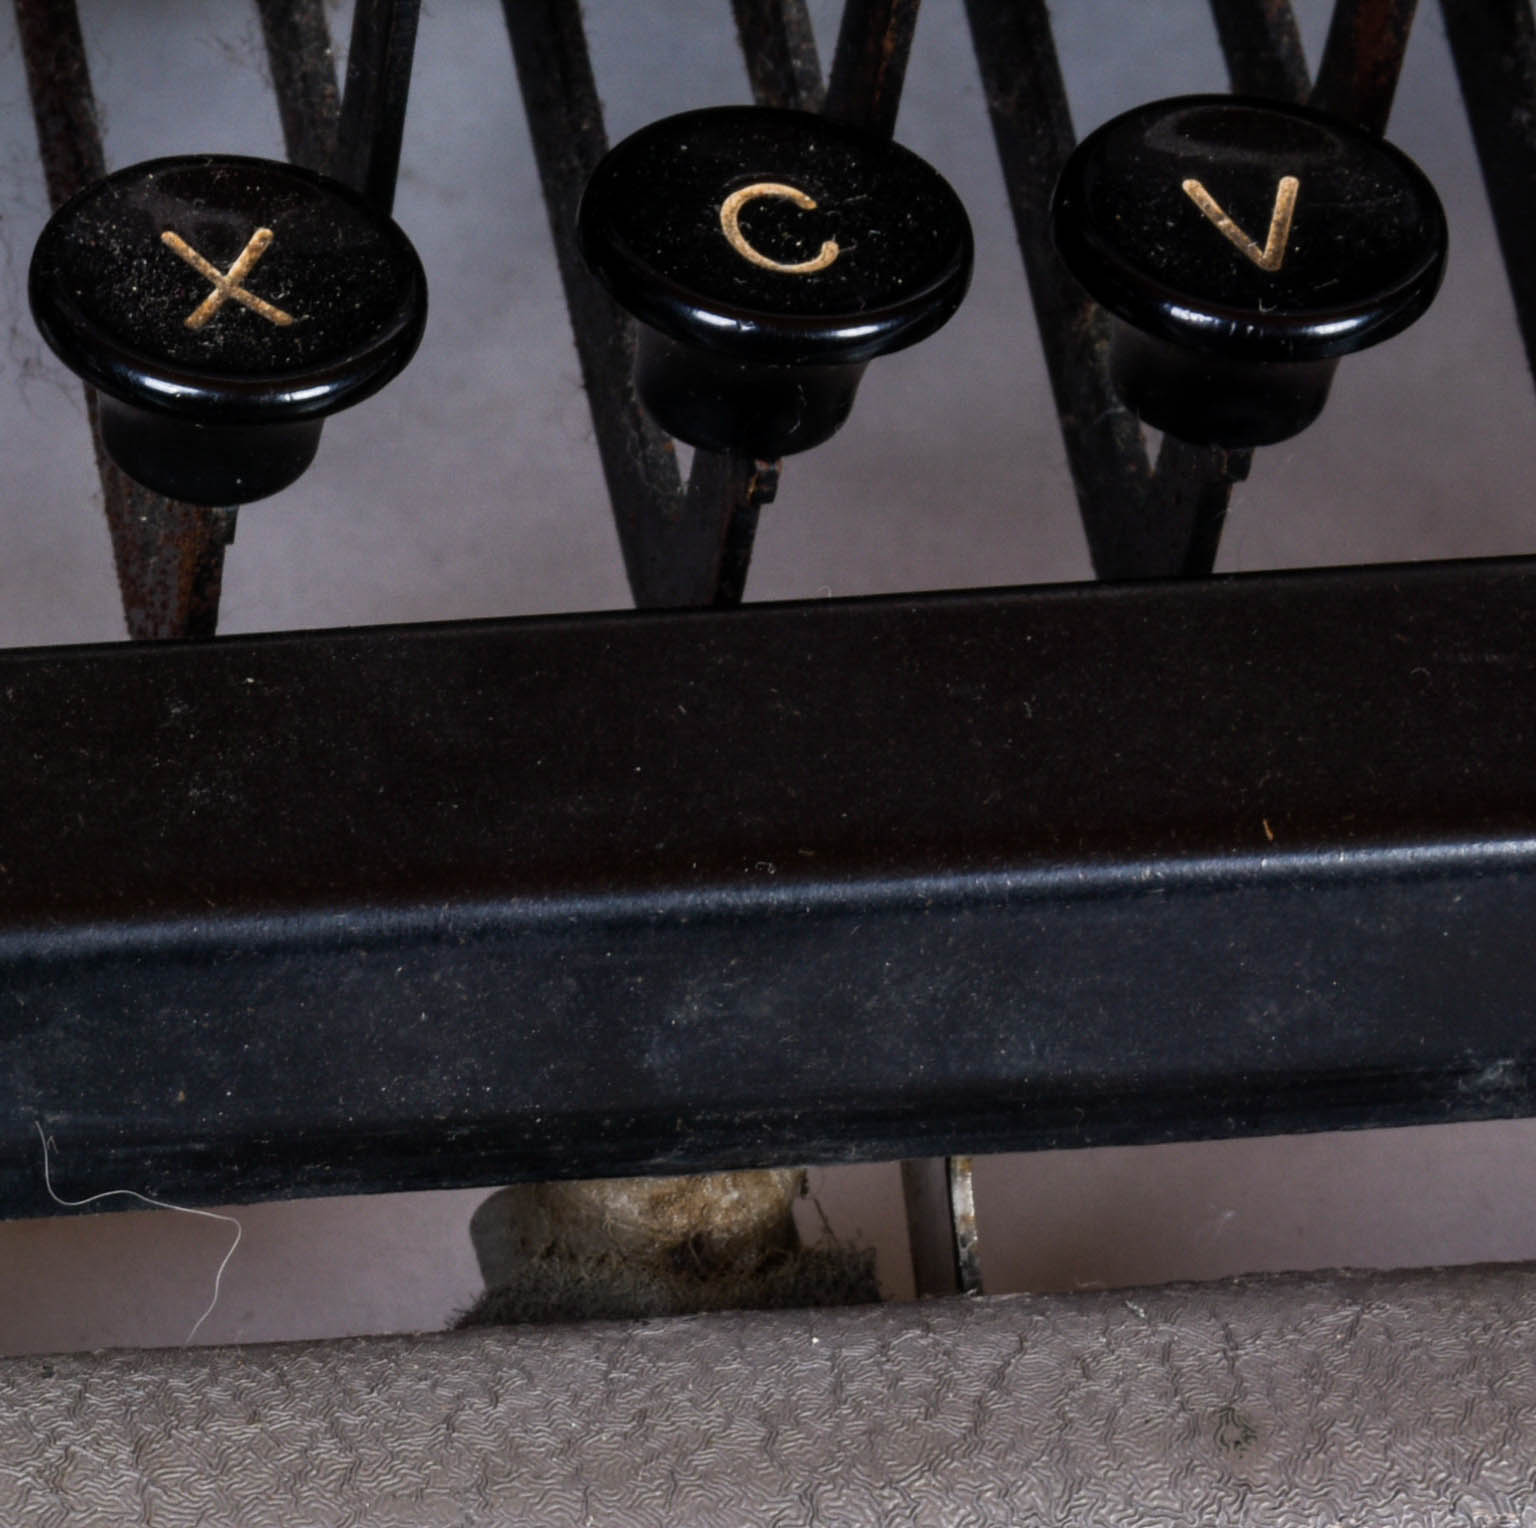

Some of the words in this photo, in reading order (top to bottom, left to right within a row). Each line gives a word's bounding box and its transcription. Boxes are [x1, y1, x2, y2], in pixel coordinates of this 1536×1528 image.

[719, 182, 840, 274] C
[1181, 175, 1301, 273] V
[160, 226, 293, 327] X
